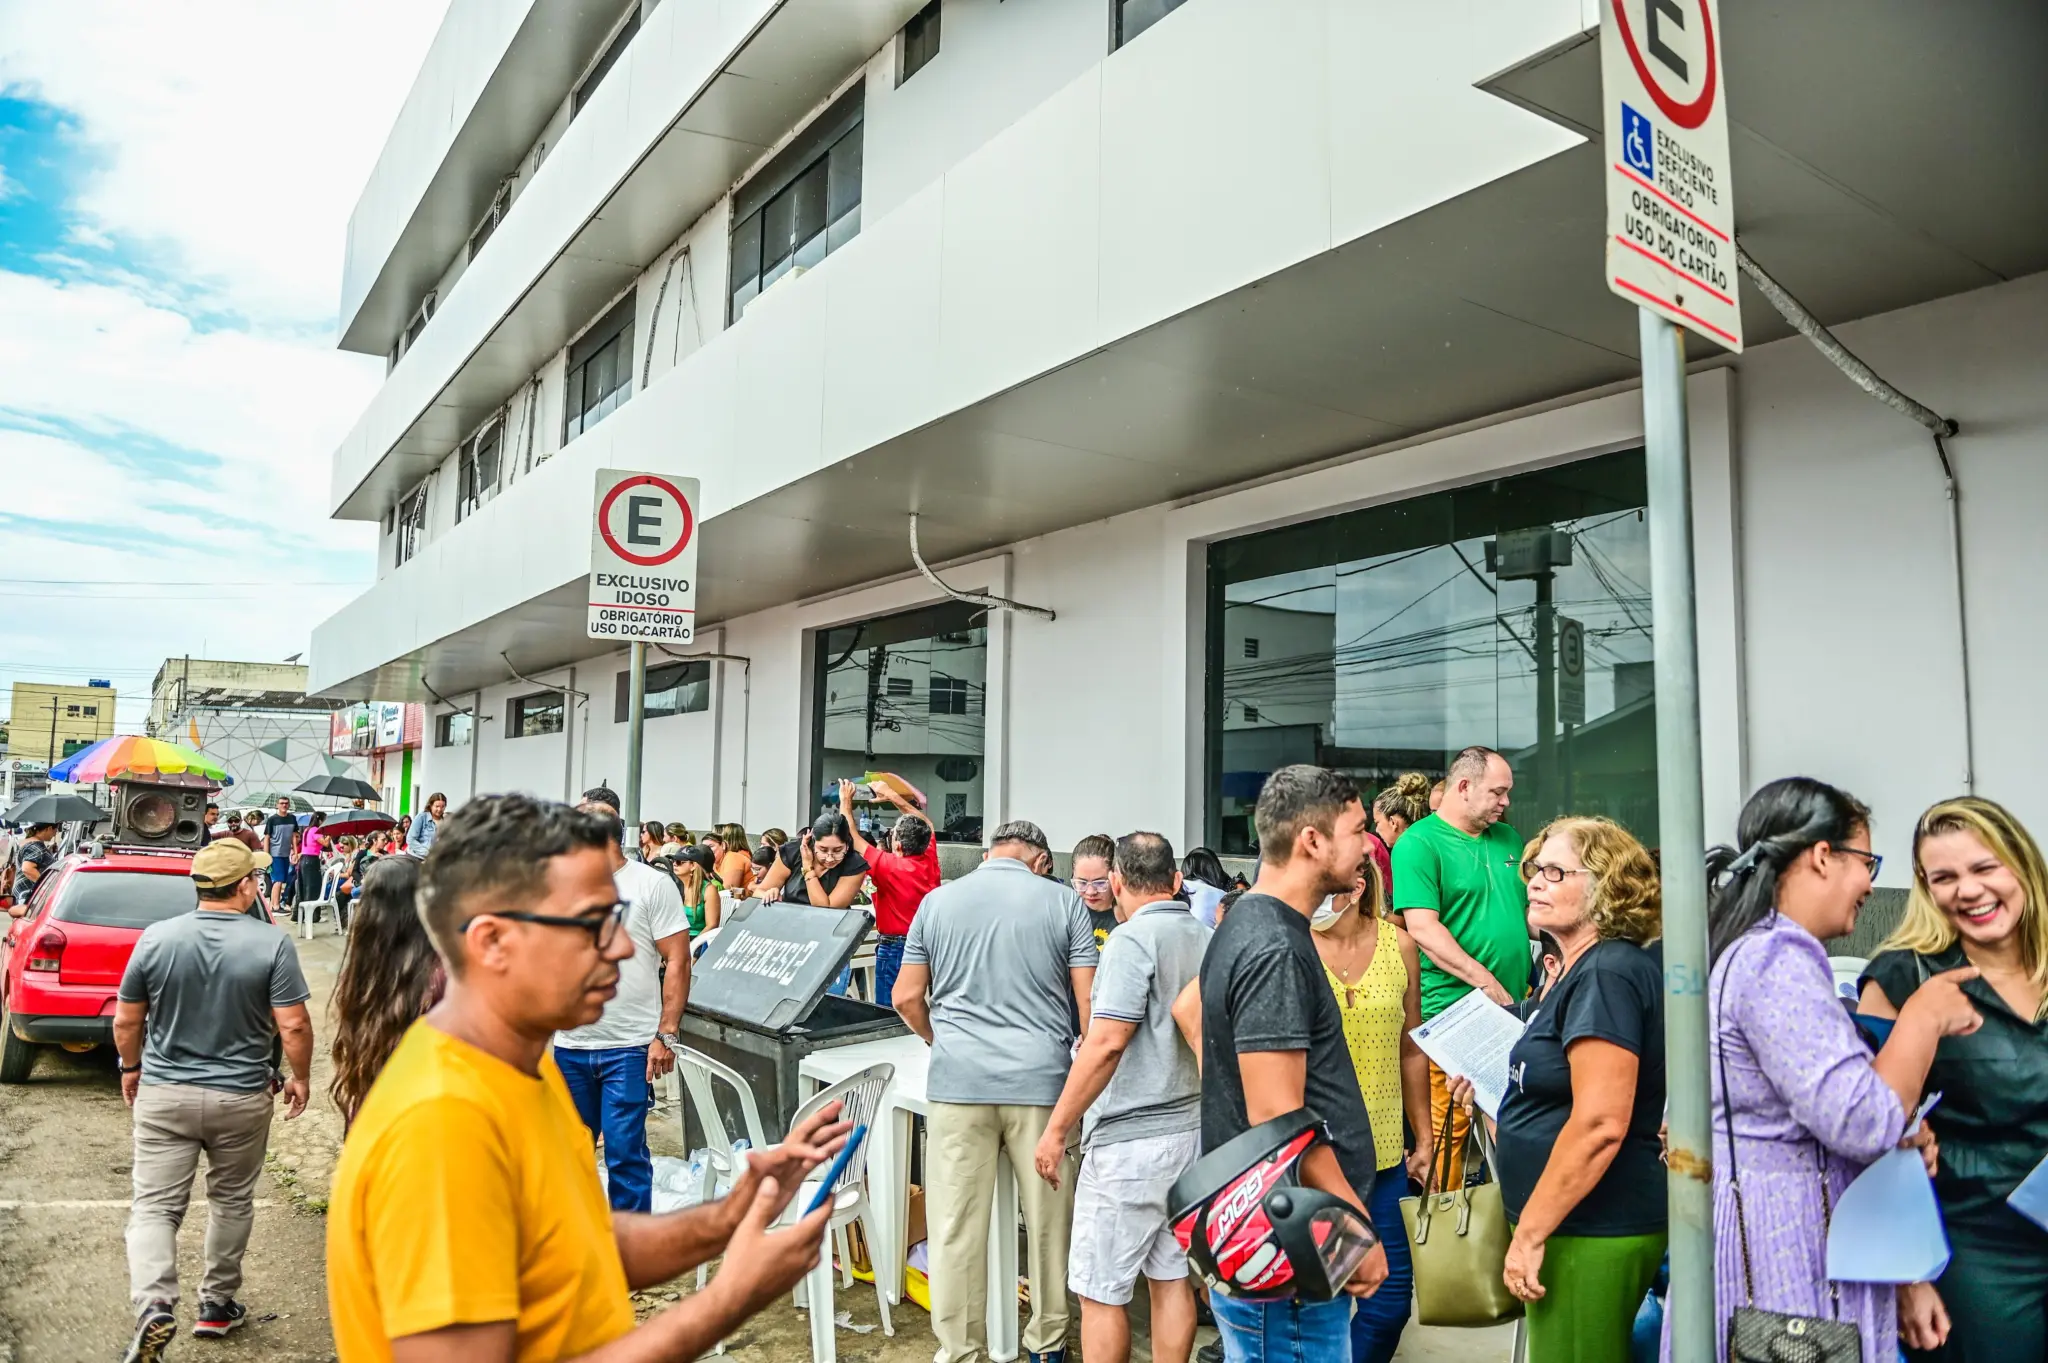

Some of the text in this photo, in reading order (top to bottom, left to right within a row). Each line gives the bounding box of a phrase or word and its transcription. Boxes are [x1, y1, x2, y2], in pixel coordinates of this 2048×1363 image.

[1656, 128, 1714, 183] EXCLUSIVO
[1657, 150, 1718, 205] DEFICIENTE
[1632, 190, 1717, 259] OBRIGATÓRIO
[1625, 213, 1727, 290] USO DO CARTÃO
[627, 495, 662, 546] E
[596, 573, 690, 592] EXCLUSIVO
[616, 591, 670, 606] IDOSO
[591, 622, 690, 639] USO DO CARTÃO
[600, 609, 683, 625] OBRIGATÓRIO
